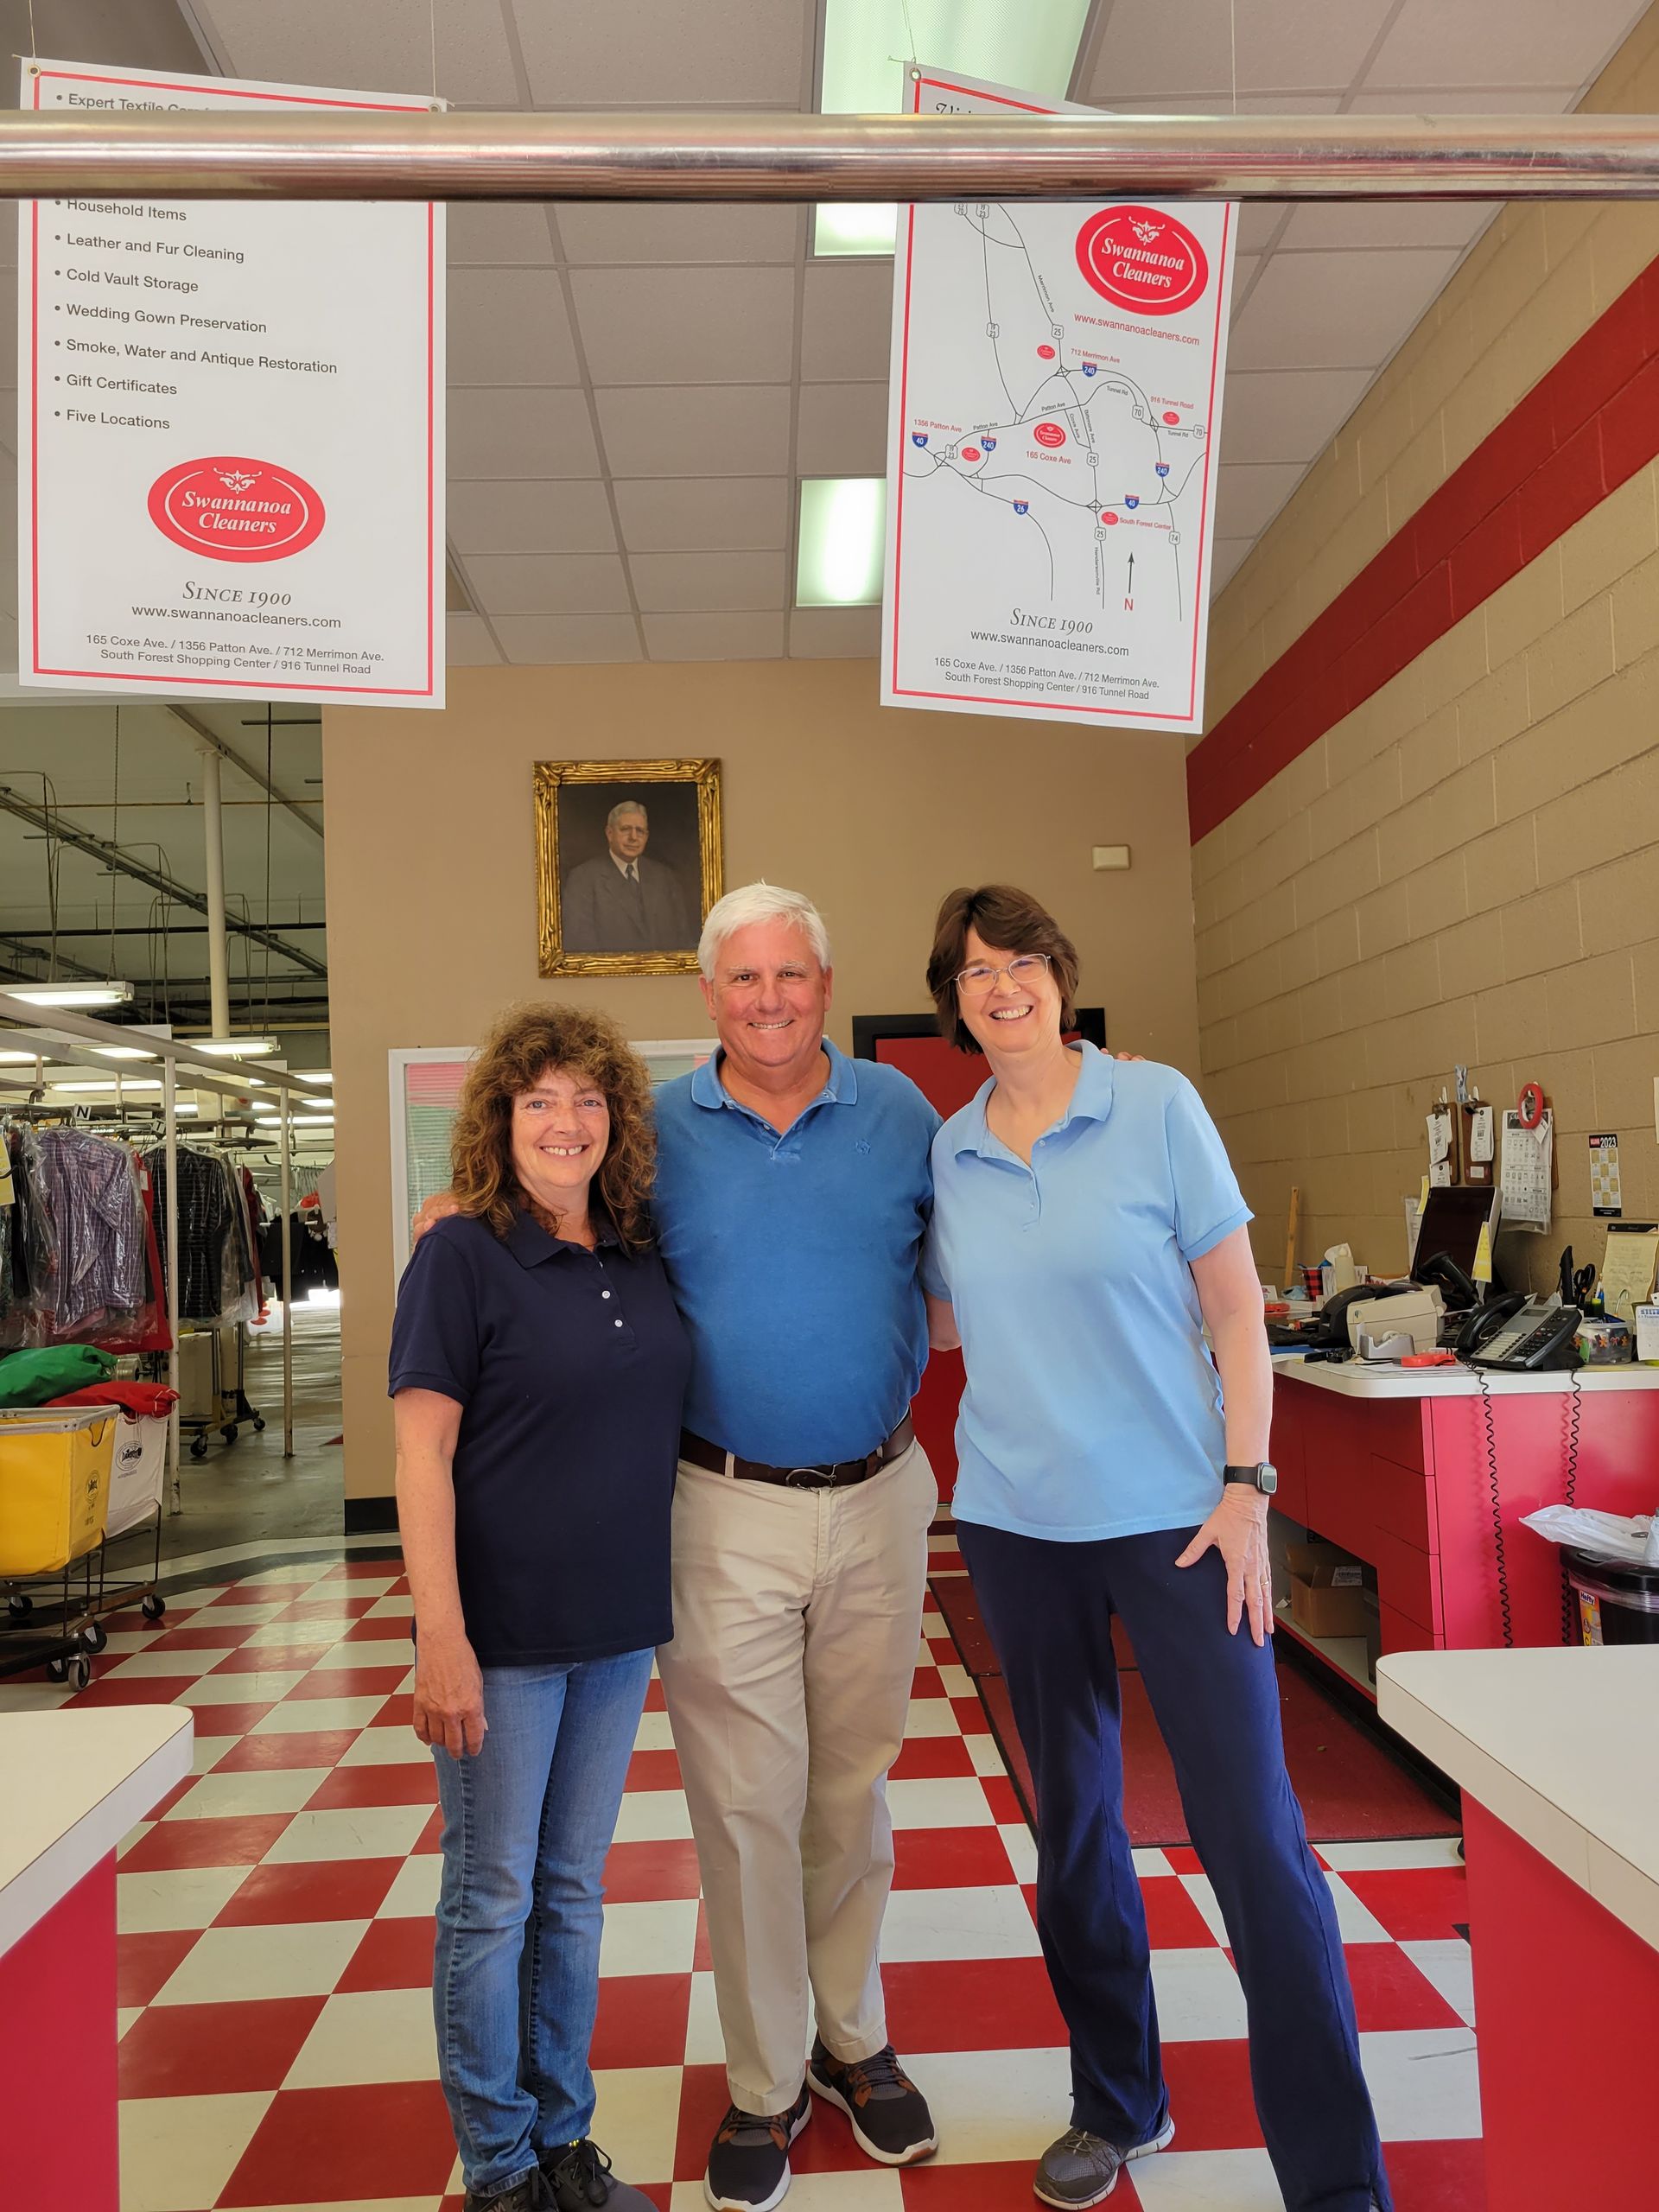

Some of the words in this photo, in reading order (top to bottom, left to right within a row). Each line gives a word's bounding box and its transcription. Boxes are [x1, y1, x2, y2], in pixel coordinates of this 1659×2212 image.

[69, 93, 115, 109] Expert
[67, 200, 143, 217] Household
[149, 207, 187, 221] Items
[67, 233, 121, 249] Leather
[125, 241, 151, 252] and
[156, 242, 180, 255] Fur
[183, 245, 244, 264] Cleaning
[1101, 238, 1185, 270] Swannanoa
[67, 269, 99, 283] Cold
[105, 271, 139, 286] Vault
[143, 276, 199, 294] Storage
[1113, 261, 1172, 288] Cleaners
[1038, 275, 1050, 302] Merrimon
[67, 303, 130, 323] Wedding
[135, 310, 175, 325] Gown
[181, 315, 266, 333] Preservation
[1054, 327, 1061, 336] 25
[1074, 314, 1199, 346] www.swannanoacleaners.com
[67, 339, 119, 356] Smoke,
[124, 344, 167, 359] Water
[170, 350, 196, 361] and
[200, 351, 254, 368] Antique
[259, 356, 337, 373] Restoration
[1083, 351, 1109, 362] Merrimon
[1084, 366, 1095, 375] 240
[67, 374, 92, 387] Gift
[97, 377, 177, 395] Certificates
[1107, 385, 1121, 394] Tunnel
[1162, 398, 1179, 407] Tunnel
[1179, 401, 1194, 410] Road
[67, 409, 96, 423] Five
[101, 412, 170, 429] Locations
[930, 422, 950, 430] Patton
[1039, 453, 1058, 462] Coxe
[1058, 456, 1071, 465] Ave
[181, 491, 291, 514] Swannanoa
[1016, 504, 1025, 512] 26
[199, 512, 276, 533] Cleaners
[1154, 522, 1172, 531] Center
[182, 581, 243, 602] SINCE
[248, 592, 291, 608] 1900
[1124, 598, 1134, 611] N
[131, 607, 340, 628] www.swannanoacleaners.com
[1010, 608, 1056, 629] SINCE
[1059, 620, 1093, 635] 1900
[86, 634, 107, 645] 165
[111, 636, 140, 646] Coxe
[143, 638, 168, 648] Ave.
[170, 639, 176, 649] /
[179, 640, 206, 651] 1356
[209, 642, 245, 653] Patton
[249, 645, 272, 655] Ave.
[276, 646, 281, 656] /
[283, 646, 303, 657] 712
[307, 648, 358, 659] Merrimon
[360, 651, 384, 661] Ave.
[970, 630, 1129, 656] www.swannanoacleaners.com
[100, 649, 134, 660] South
[138, 652, 174, 663] Forest
[176, 654, 230, 668] Shopping
[233, 658, 271, 668] Center
[273, 659, 278, 669] /
[281, 660, 301, 671] 916
[303, 662, 339, 672] Tunnel
[343, 664, 371, 674] Road
[935, 658, 950, 667] 165
[953, 658, 976, 670] Coxe
[978, 661, 997, 672] Ave.
[999, 664, 1003, 672] /
[1006, 664, 1027, 675] 1356
[1028, 666, 1056, 677] Patton
[1058, 670, 1077, 680] Ave.
[1078, 671, 1083, 680] /
[1084, 672, 1099, 682] 712
[1102, 674, 1140, 686] Merrimon
[1141, 678, 1160, 688] Ave.
[945, 671, 970, 683] South
[974, 674, 1001, 685] Forest
[1003, 677, 1044, 692] Shopping
[1046, 682, 1075, 692] Center
[1076, 684, 1081, 693] /
[1082, 685, 1097, 695] 916
[1099, 686, 1126, 697] Tunnel
[1128, 690, 1149, 700] Road
[76, 1106, 89, 1118] N
[1600, 1136, 1617, 1148] 2023
